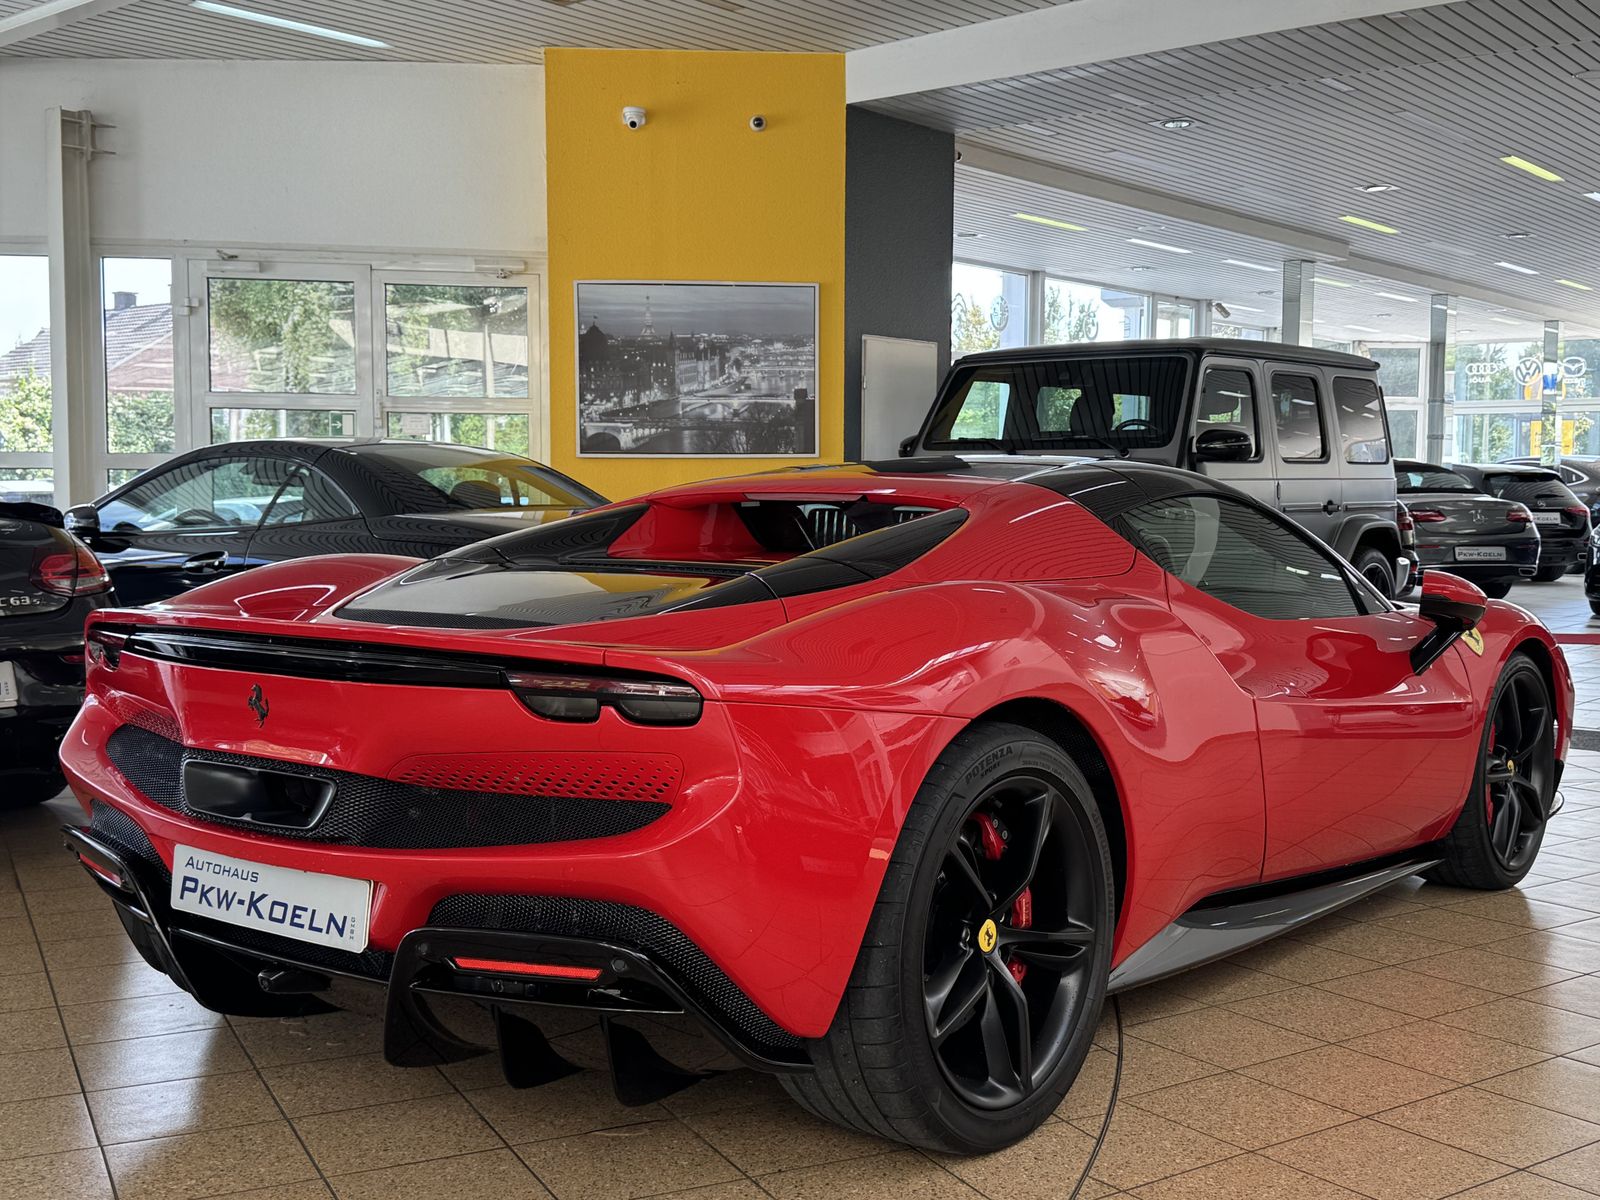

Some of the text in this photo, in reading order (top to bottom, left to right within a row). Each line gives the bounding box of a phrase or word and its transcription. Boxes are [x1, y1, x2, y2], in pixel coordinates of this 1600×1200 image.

[964, 745, 1013, 784] POTENZA
[184, 856, 259, 883] AUTOHAUS
[179, 875, 348, 938] PKW-KOELN
